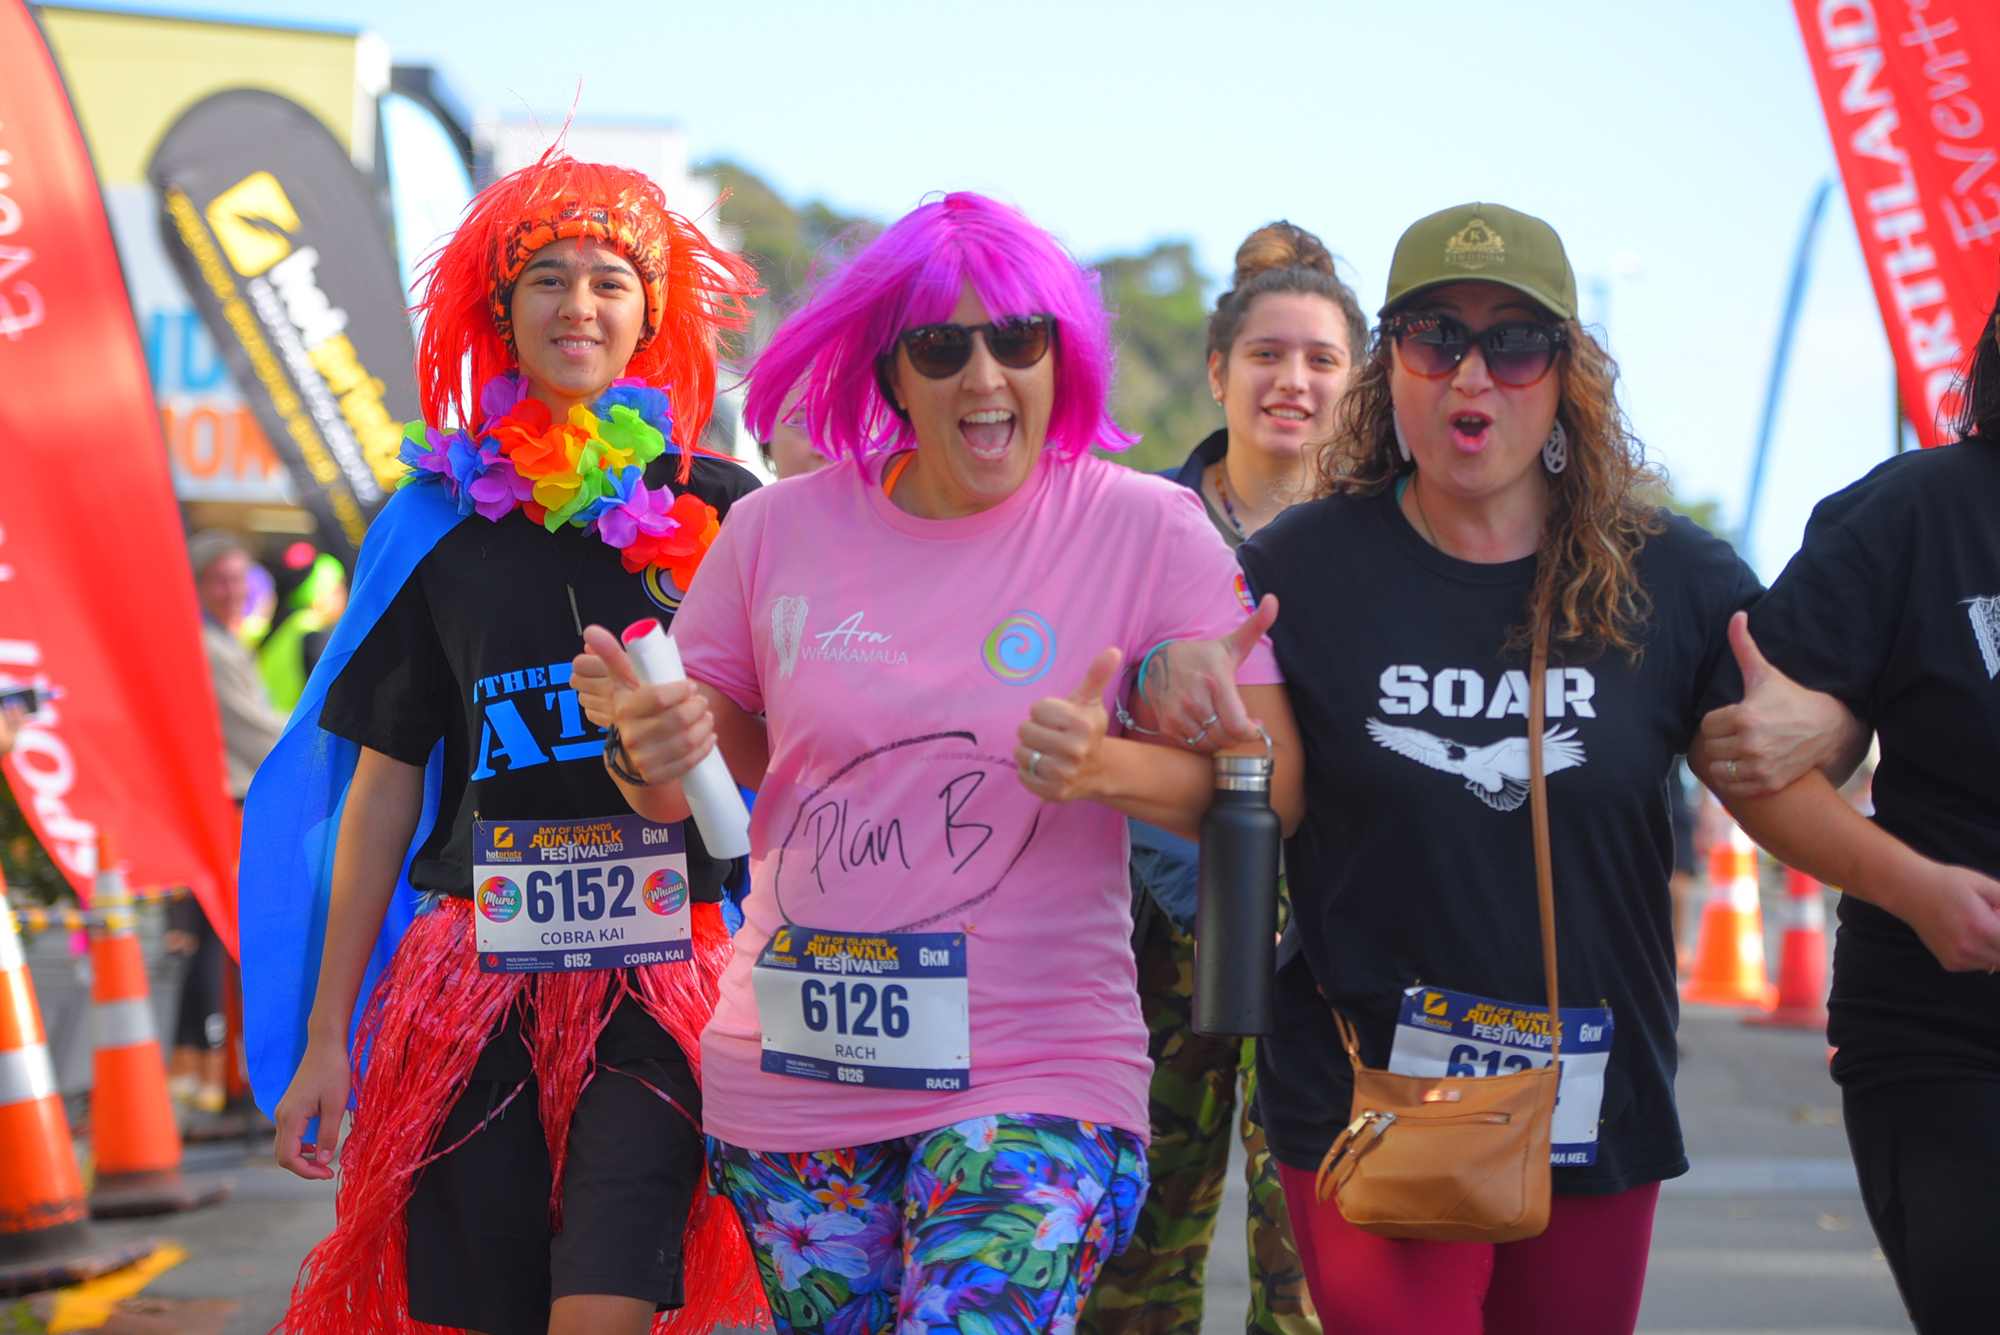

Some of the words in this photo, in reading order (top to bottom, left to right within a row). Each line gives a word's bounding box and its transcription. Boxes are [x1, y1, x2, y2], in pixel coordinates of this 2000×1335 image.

[1816, 0, 1980, 446] ORTHLAND
[815, 610, 893, 650] Ara
[800, 646, 909, 666] WHAKAMAUA
[478, 666, 547, 698] THE
[1377, 664, 1597, 719] SOAR
[539, 827, 557, 835] BAY
[558, 826, 571, 834] OF
[573, 823, 612, 833] ISLANDS
[642, 827, 669, 846] 6KM
[803, 799, 911, 894] Plan
[938, 771, 993, 875] B
[529, 834, 568, 849] RUN
[573, 829, 623, 846] WALK
[486, 850, 522, 860] hotprintz
[541, 841, 608, 863] FESTIVAL
[604, 843, 624, 853] 2023
[526, 865, 637, 924] 6152
[540, 930, 595, 946] COBRA
[599, 927, 625, 943] KAI
[814, 935, 830, 945] BAY
[832, 937, 845, 945] OF
[847, 938, 887, 947] ISLANDS
[563, 953, 592, 968] 6152
[623, 951, 664, 965] COBRA
[665, 949, 684, 963] KAI
[803, 942, 843, 957] RUN
[846, 946, 899, 960] WALK
[919, 948, 949, 967] 6KM
[815, 952, 883, 975] FESTIVAL
[878, 960, 899, 970] 2023
[801, 979, 910, 1039] 6126
[1462, 1009, 1509, 1027] RUN
[1476, 1003, 1494, 1014] BAY
[1498, 1008, 1512, 1017] OF
[1514, 1010, 1552, 1021] ISLAND
[1472, 1023, 1544, 1048] FESTIVAL
[1541, 1035, 1563, 1046] 203
[1579, 1023, 1603, 1042] 6KM
[835, 1044, 876, 1060] RACH
[837, 1067, 864, 1083] 6126
[926, 1078, 960, 1089] RACH
[1567, 1152, 1588, 1163] MEL
